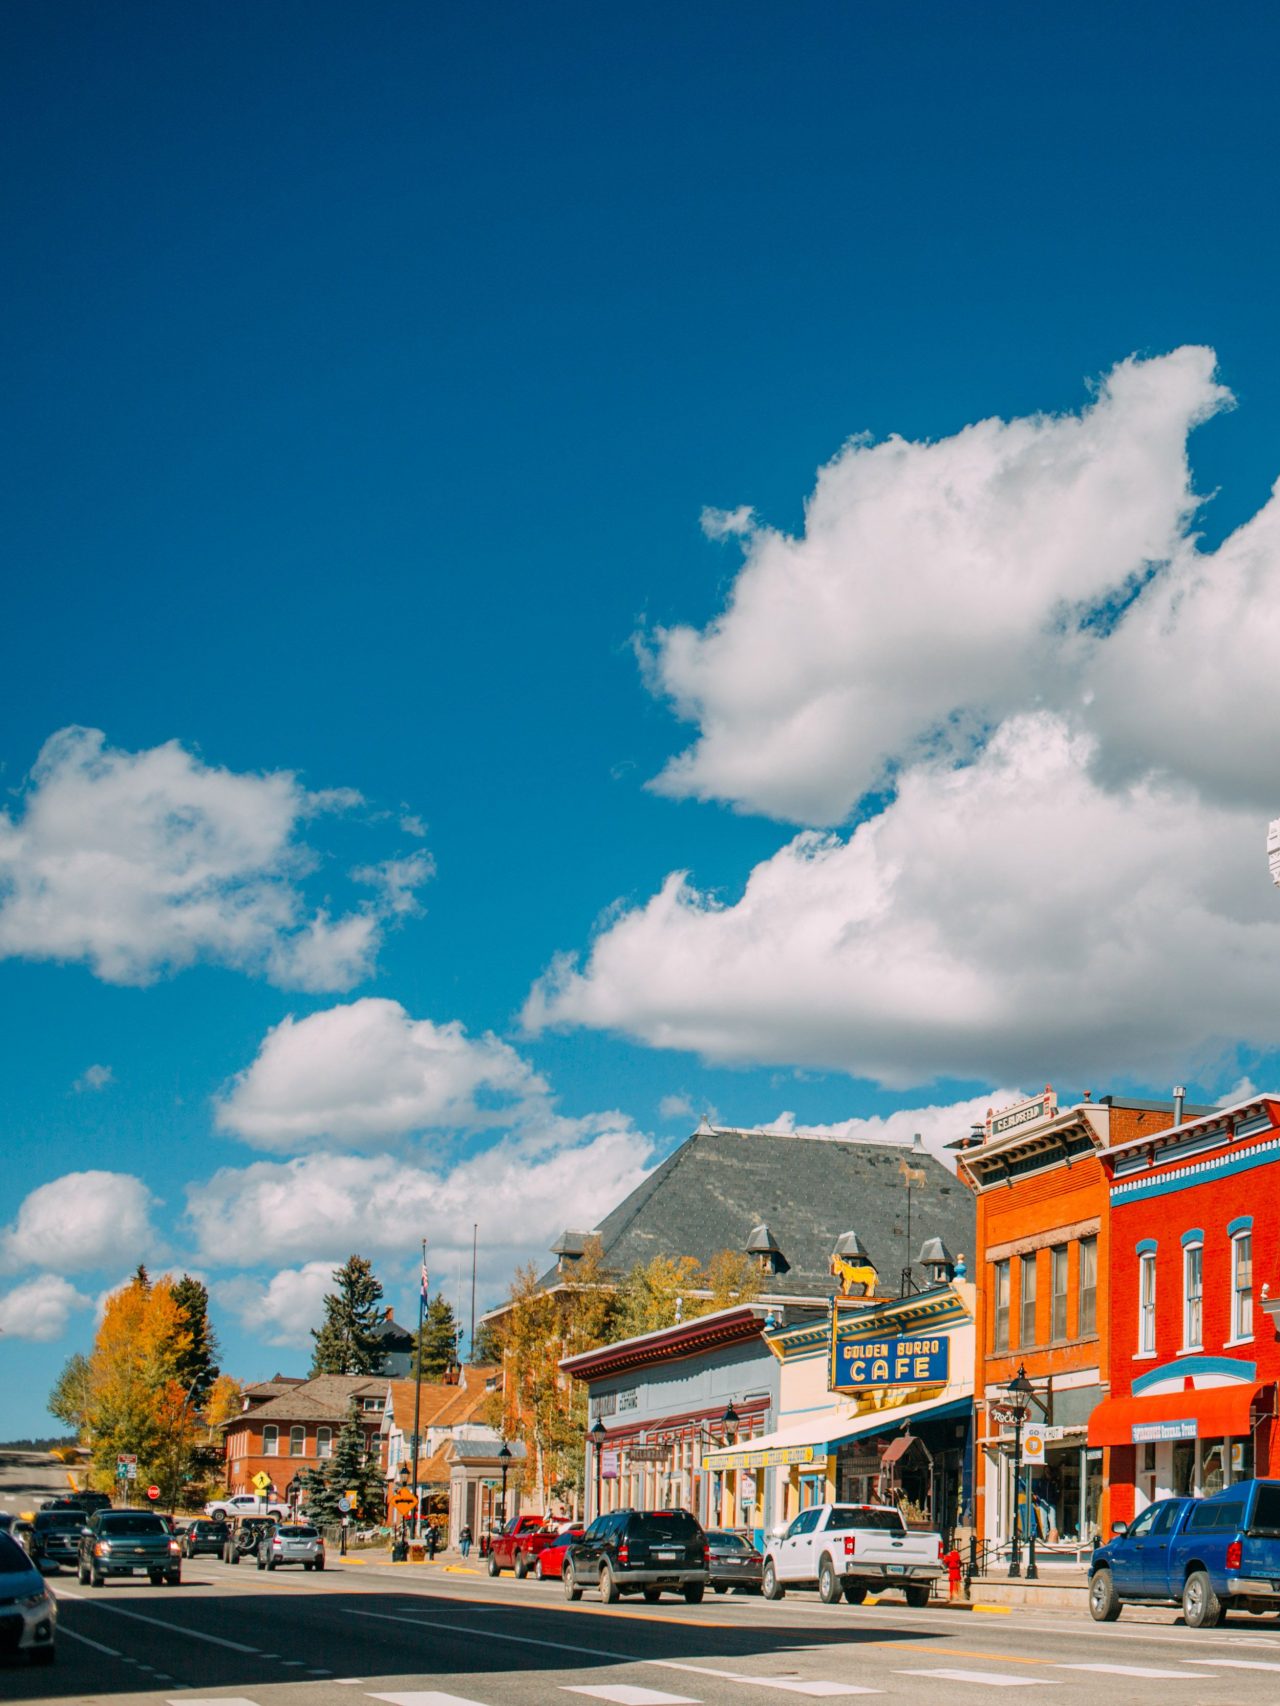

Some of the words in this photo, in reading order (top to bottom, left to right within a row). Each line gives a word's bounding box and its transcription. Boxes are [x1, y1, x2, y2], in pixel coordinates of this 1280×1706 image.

[843, 1343, 889, 1360] GOLDEN
[896, 1339, 939, 1357] BURRO
[849, 1356, 931, 1382] CAFE
